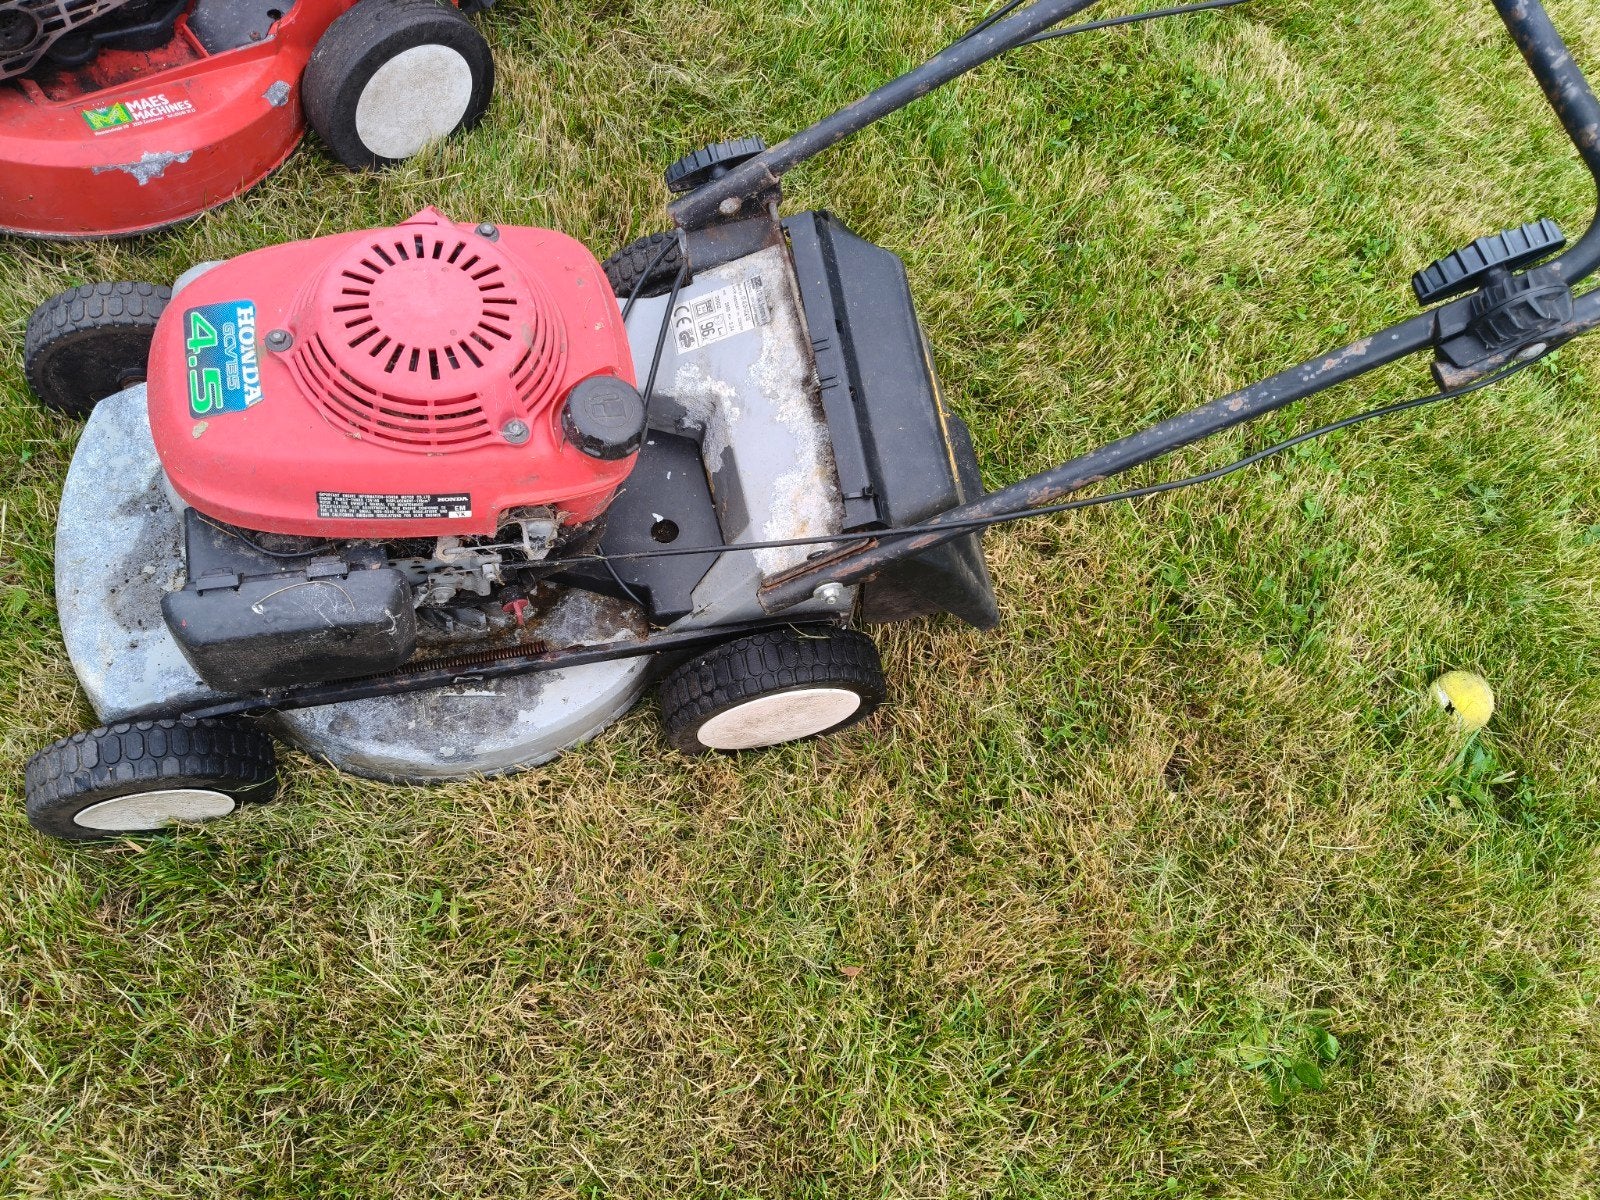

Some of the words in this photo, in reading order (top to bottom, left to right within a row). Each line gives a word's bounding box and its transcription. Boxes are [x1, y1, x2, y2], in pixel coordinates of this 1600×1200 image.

[125, 94, 169, 112] MAES
[132, 100, 192, 121] MACHINES
[700, 321, 715, 337] 96
[187, 311, 223, 413] 4.5
[237, 306, 262, 405] HONDA
